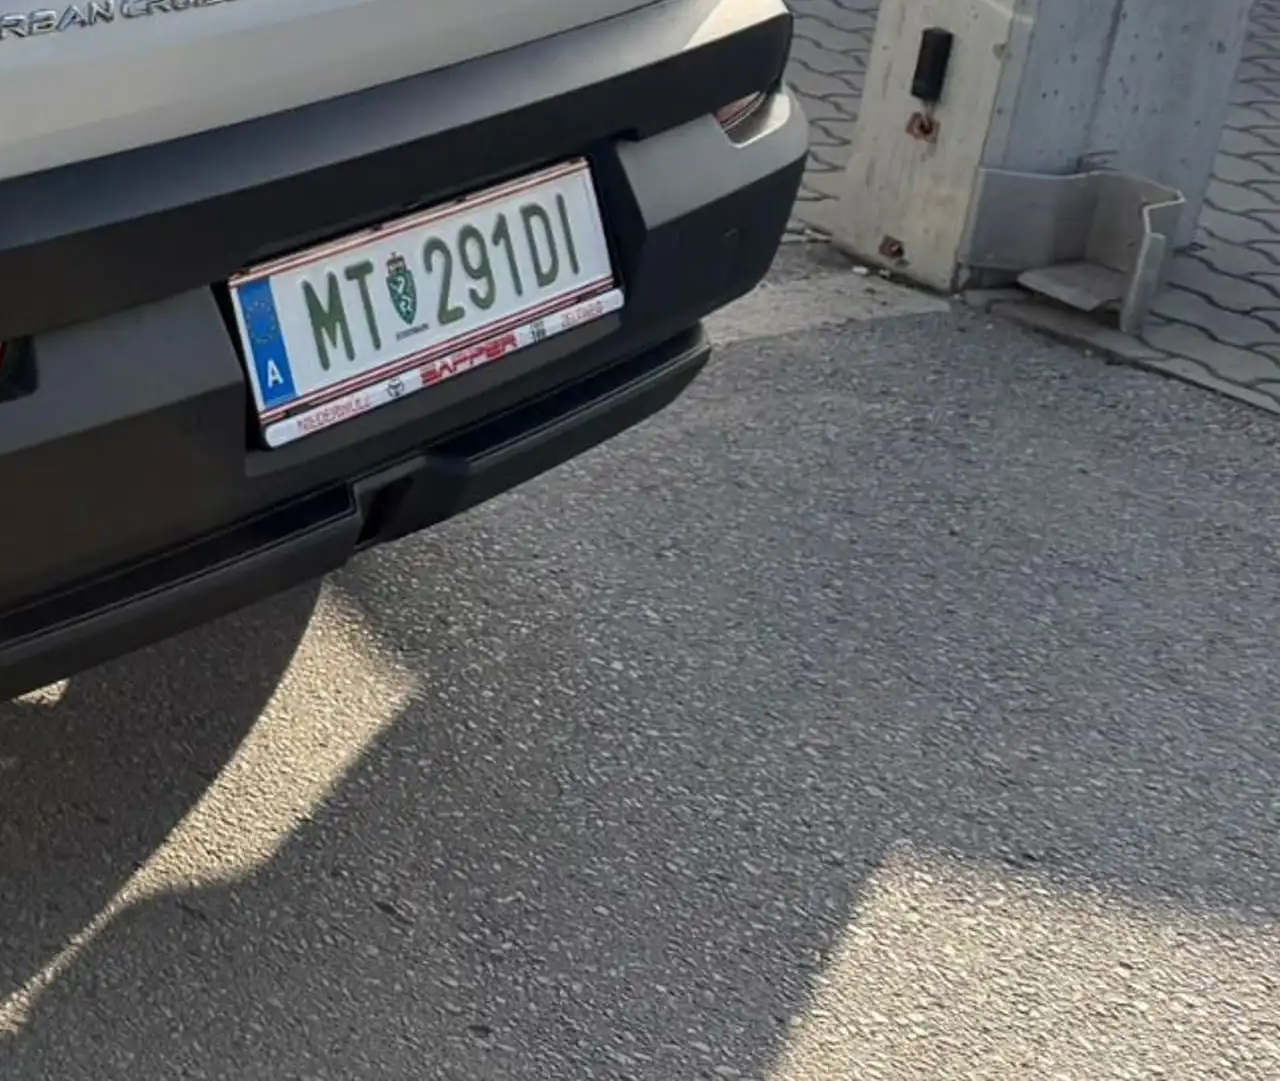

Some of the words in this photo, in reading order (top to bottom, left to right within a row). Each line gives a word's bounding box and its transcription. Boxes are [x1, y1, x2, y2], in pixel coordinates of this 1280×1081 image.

[302, 261, 382, 371] MT
[423, 194, 579, 323] 291DI
[267, 360, 284, 387] A
[419, 333, 519, 387] SAPPER
